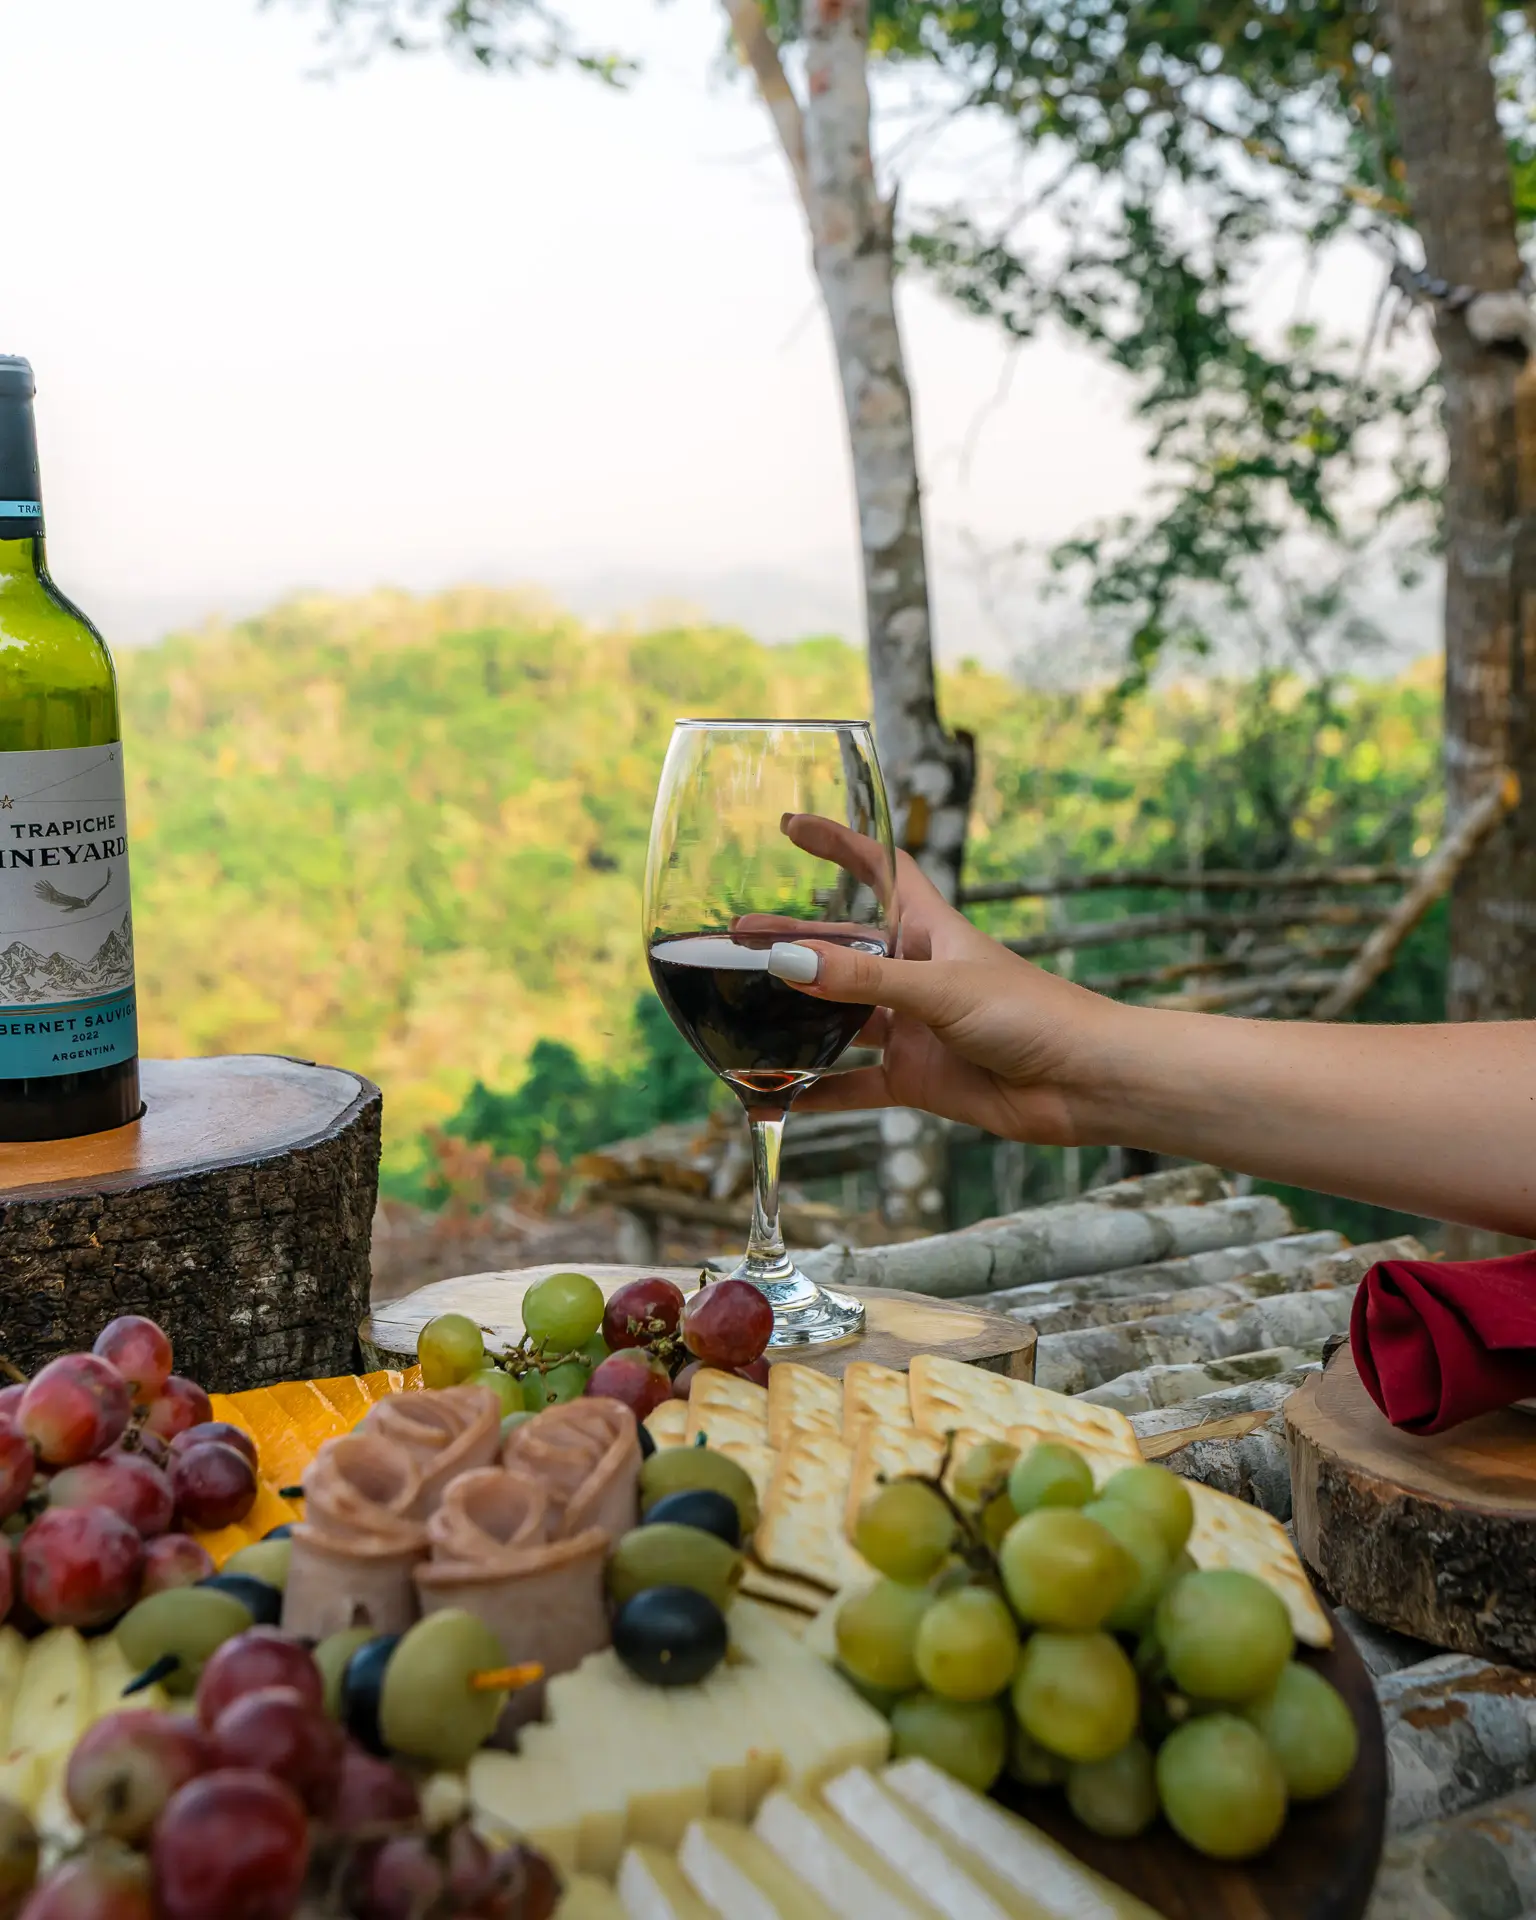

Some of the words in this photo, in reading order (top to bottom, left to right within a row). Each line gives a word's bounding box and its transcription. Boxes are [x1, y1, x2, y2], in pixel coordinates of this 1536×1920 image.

[10, 814, 116, 839] TRAPICHE
[71, 1030, 99, 1043] 2022
[52, 1043, 115, 1062] ARGENTINA
